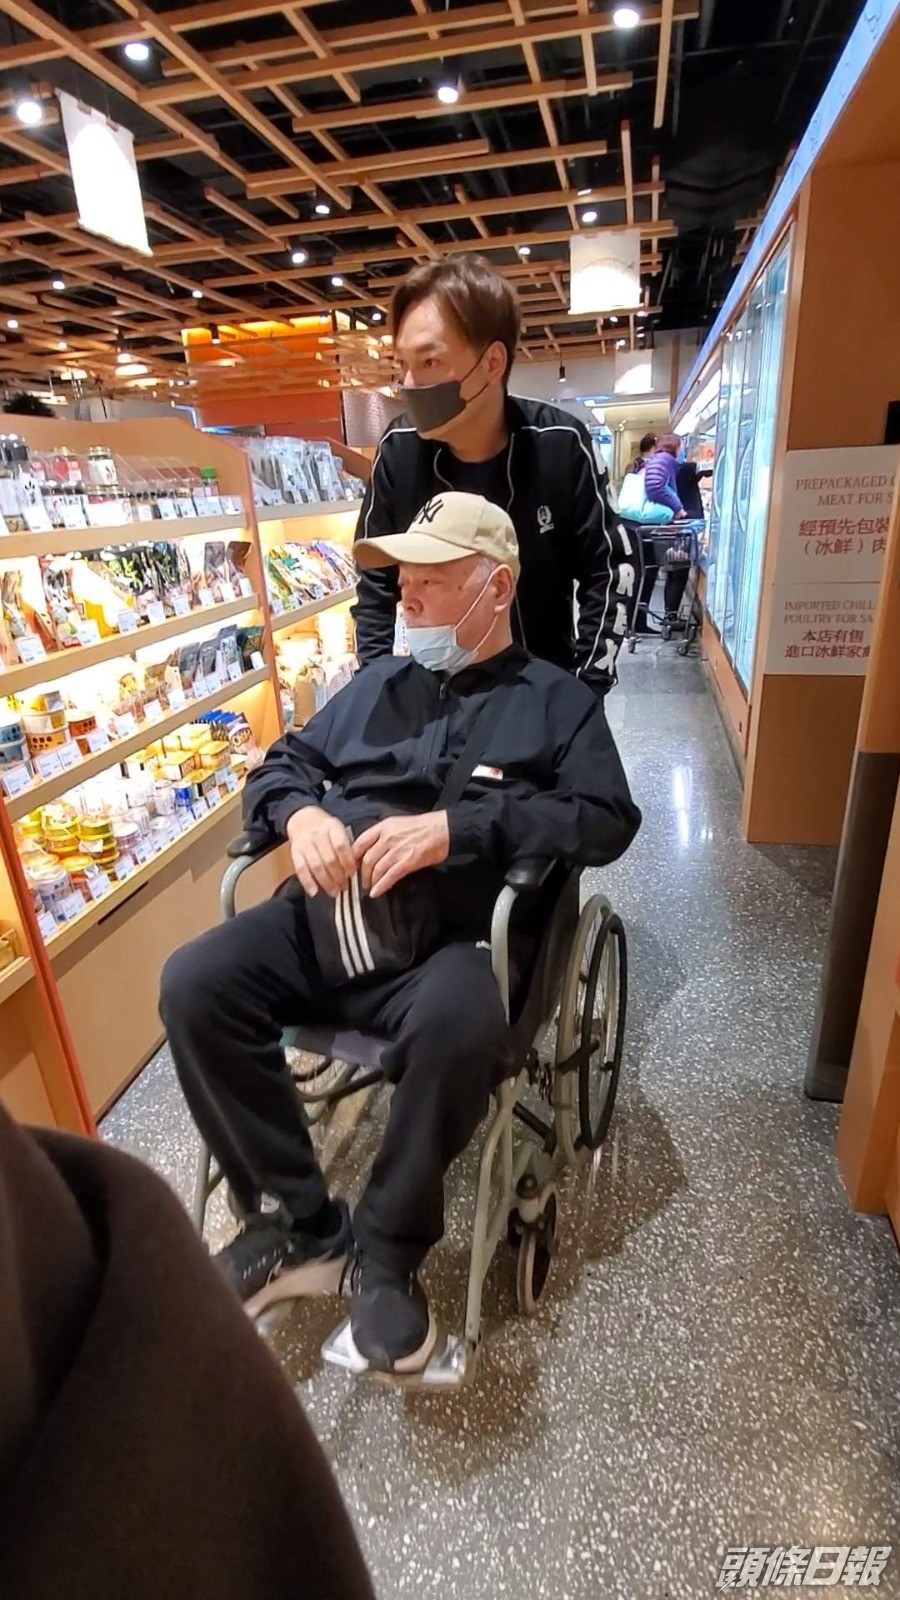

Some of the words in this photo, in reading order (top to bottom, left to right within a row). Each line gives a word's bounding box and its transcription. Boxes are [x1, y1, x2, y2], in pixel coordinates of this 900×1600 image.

[796, 475, 888, 490] PREPACKAGED
[818, 494, 854, 506] MEAT
[858, 492, 883, 504] FOR
[785, 600, 840, 611] IMPORTED
[784, 613, 832, 623] POULTRY
[836, 613, 857, 623] FOR
[801, 629, 865, 643] 本店有售
